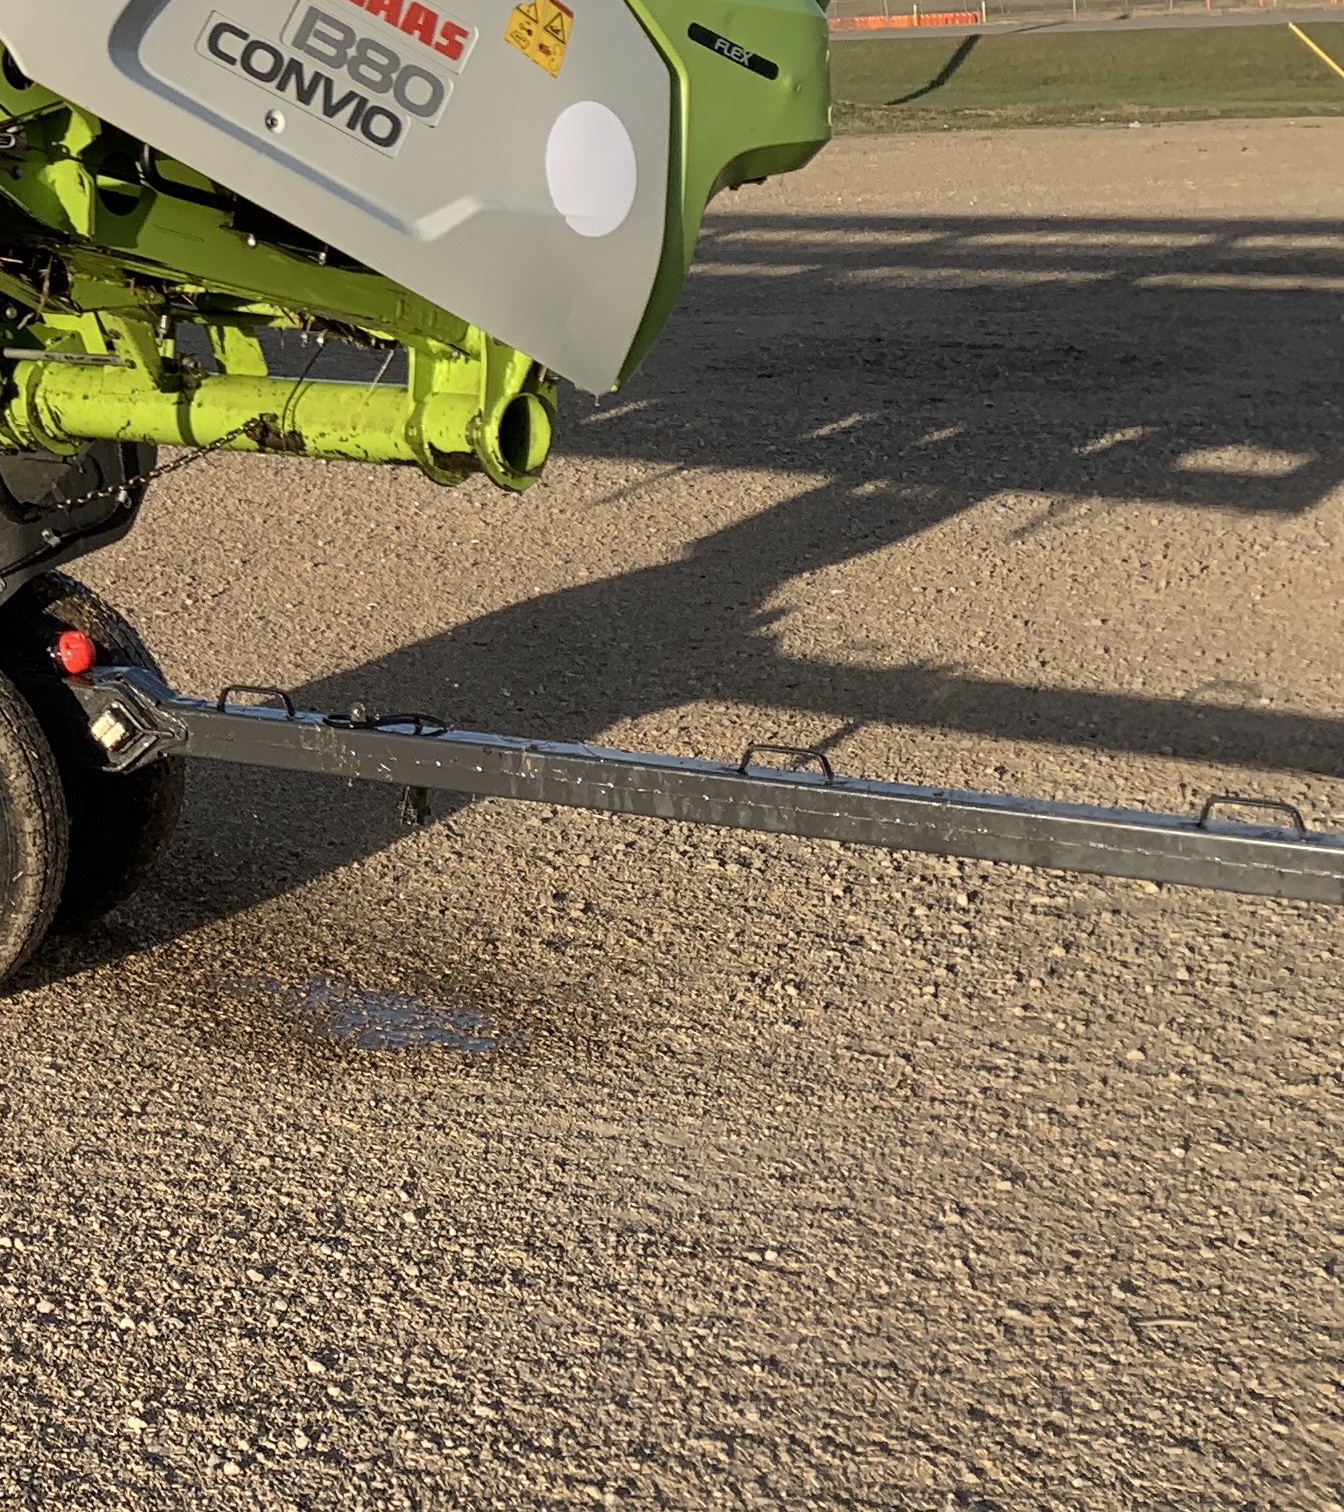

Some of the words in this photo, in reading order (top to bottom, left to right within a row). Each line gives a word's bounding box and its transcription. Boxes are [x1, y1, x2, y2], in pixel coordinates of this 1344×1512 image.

[207, 21, 403, 148] CONVIO
[291, 5, 445, 118] B80
[714, 38, 753, 67] FLEX
